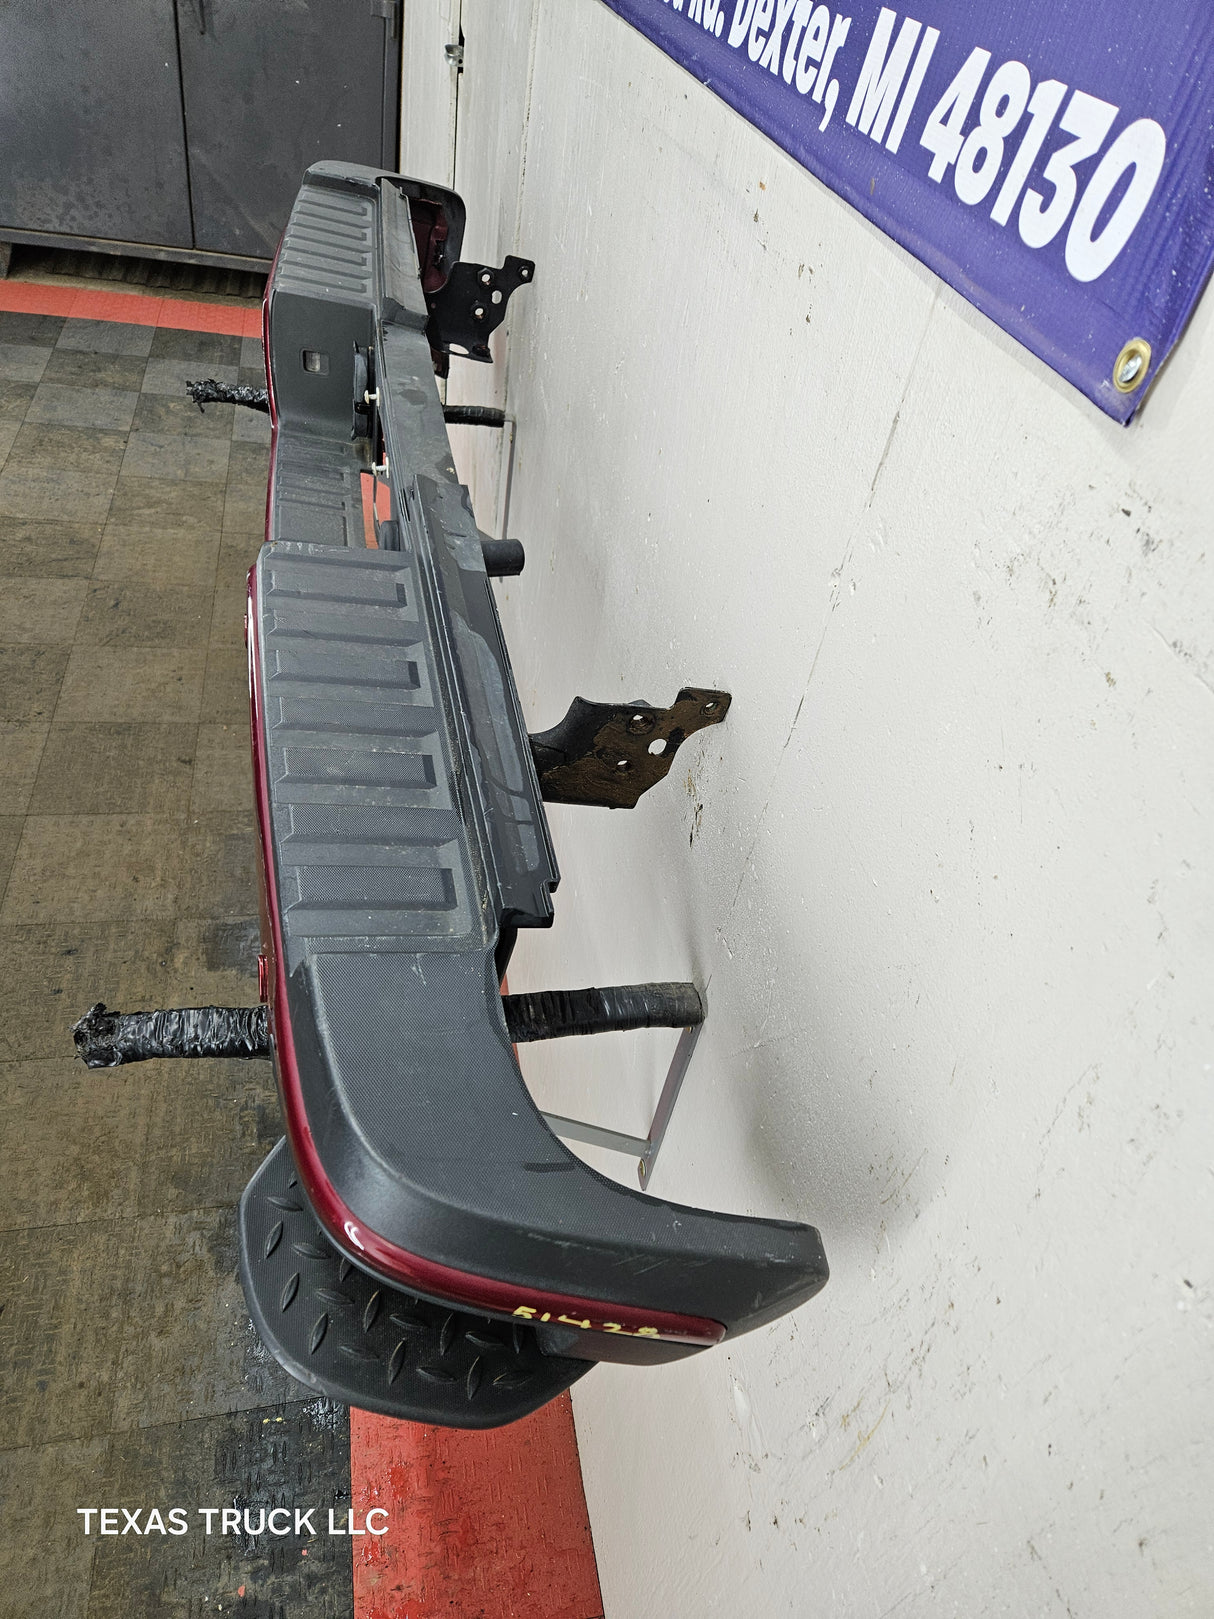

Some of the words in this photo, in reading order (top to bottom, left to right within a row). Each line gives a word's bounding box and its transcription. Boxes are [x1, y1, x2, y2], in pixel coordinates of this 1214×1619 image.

[727, 0, 852, 132] Dexter,
[845, 7, 941, 154] MI
[919, 46, 1166, 282] 48130
